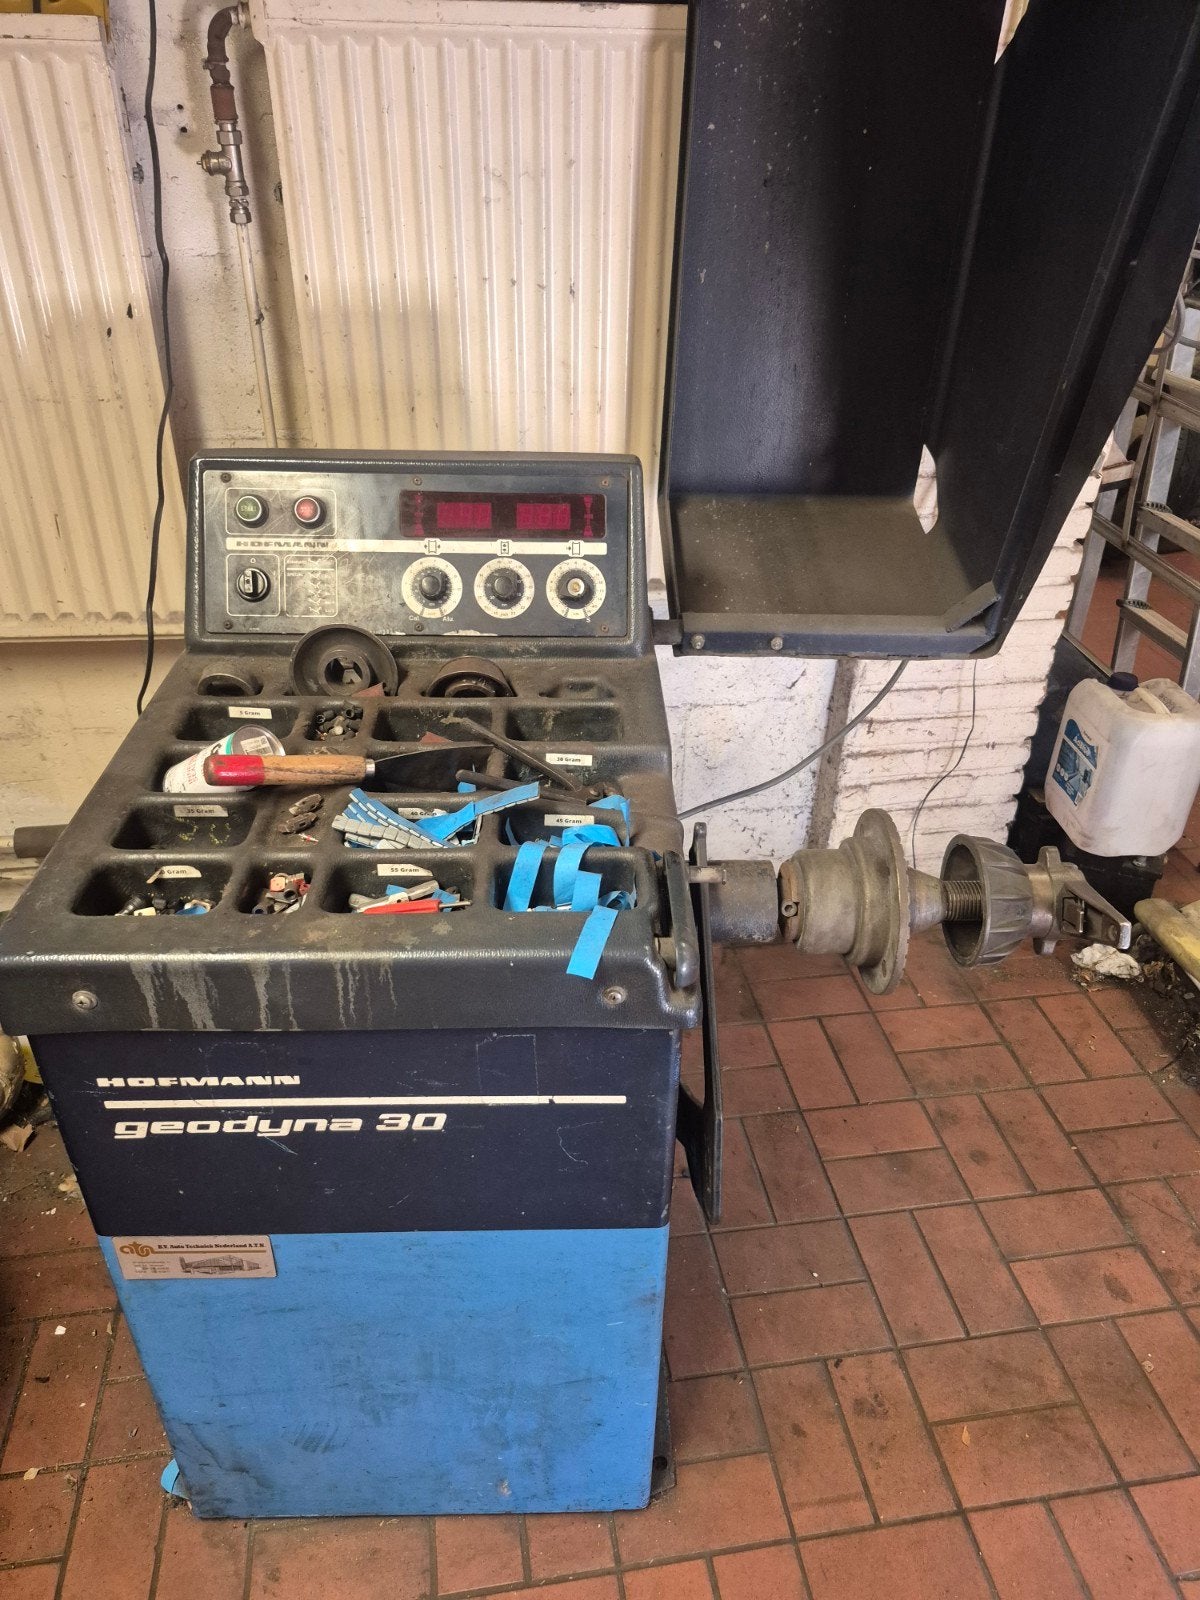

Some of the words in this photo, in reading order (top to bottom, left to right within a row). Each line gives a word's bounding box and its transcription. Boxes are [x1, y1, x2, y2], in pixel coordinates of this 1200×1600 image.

[96, 1076, 300, 1087] HOFMANN
[114, 1116, 362, 1138] geodyna
[376, 1113, 447, 1131] 30
